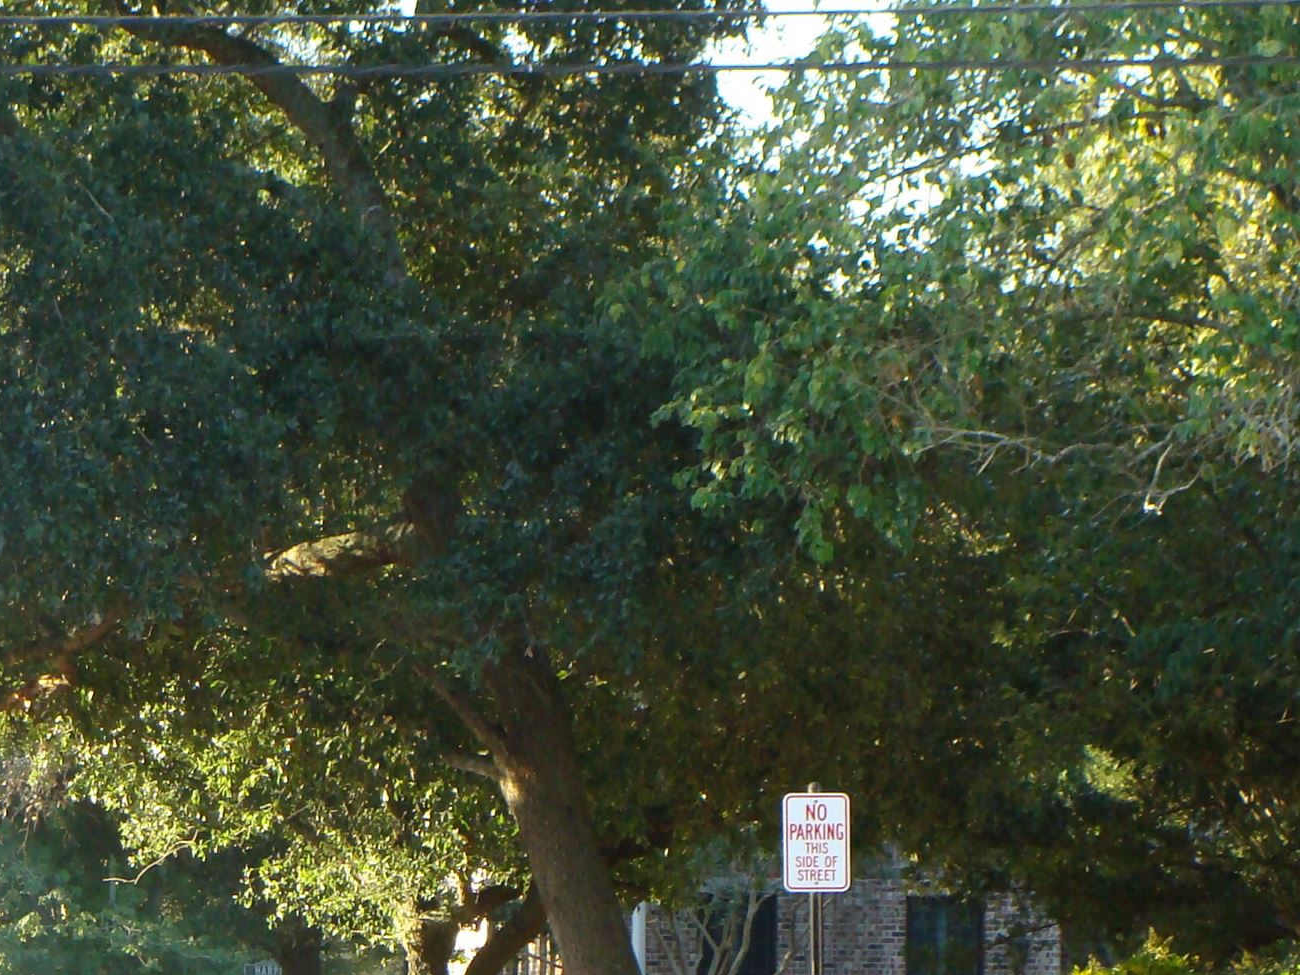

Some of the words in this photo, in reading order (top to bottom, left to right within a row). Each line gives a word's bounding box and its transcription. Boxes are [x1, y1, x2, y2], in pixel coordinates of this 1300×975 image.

[806, 804, 827, 821] NO
[789, 823, 844, 840] PARKING
[805, 842, 829, 854] THIS
[795, 855, 819, 868] SIDE
[824, 855, 838, 868] OF
[797, 869, 836, 881] STREET
